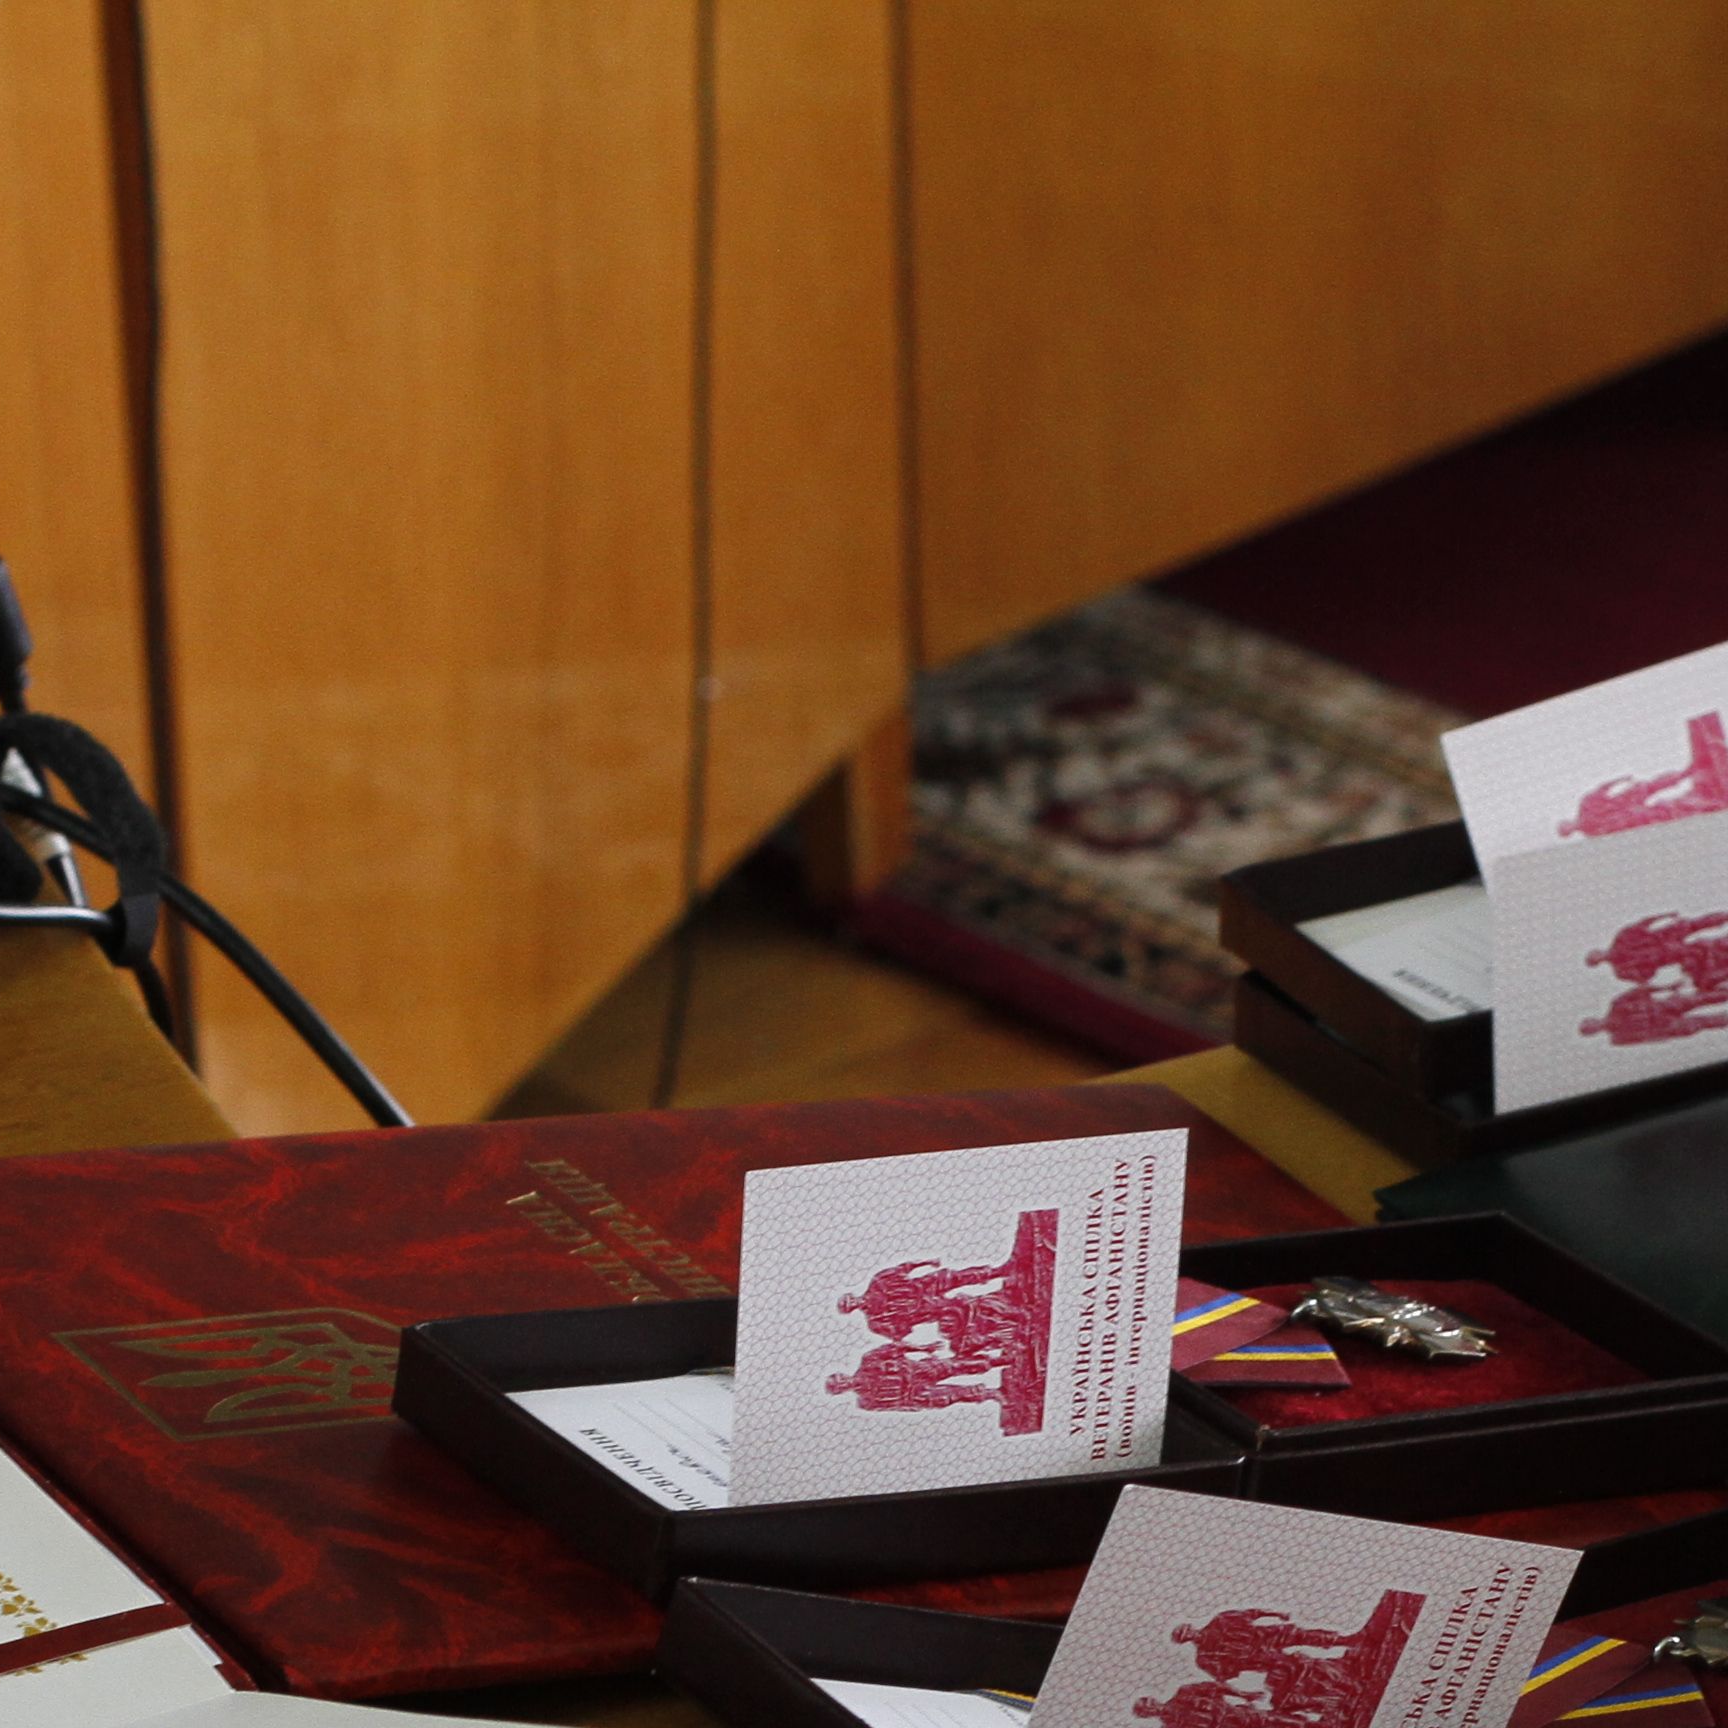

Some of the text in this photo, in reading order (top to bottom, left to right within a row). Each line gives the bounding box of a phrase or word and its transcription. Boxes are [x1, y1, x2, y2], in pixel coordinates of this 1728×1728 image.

[1069, 1188, 1105, 1437] УКРАЇНСЬКА СПІЛКА
[1089, 1158, 1132, 1463] ВЕТЕРАНІВ АФГАНІСТАНУ
[1123, 1154, 1158, 1366] інтернаціоналістів)
[579, 1428, 707, 1511] ПОСВІДЧЕННЯ
[1114, 1384, 1137, 1460] (воїнів
[1427, 1586, 1480, 1671] СПІЛКА
[1433, 1561, 1514, 1722] АФГАНІСТАНУ
